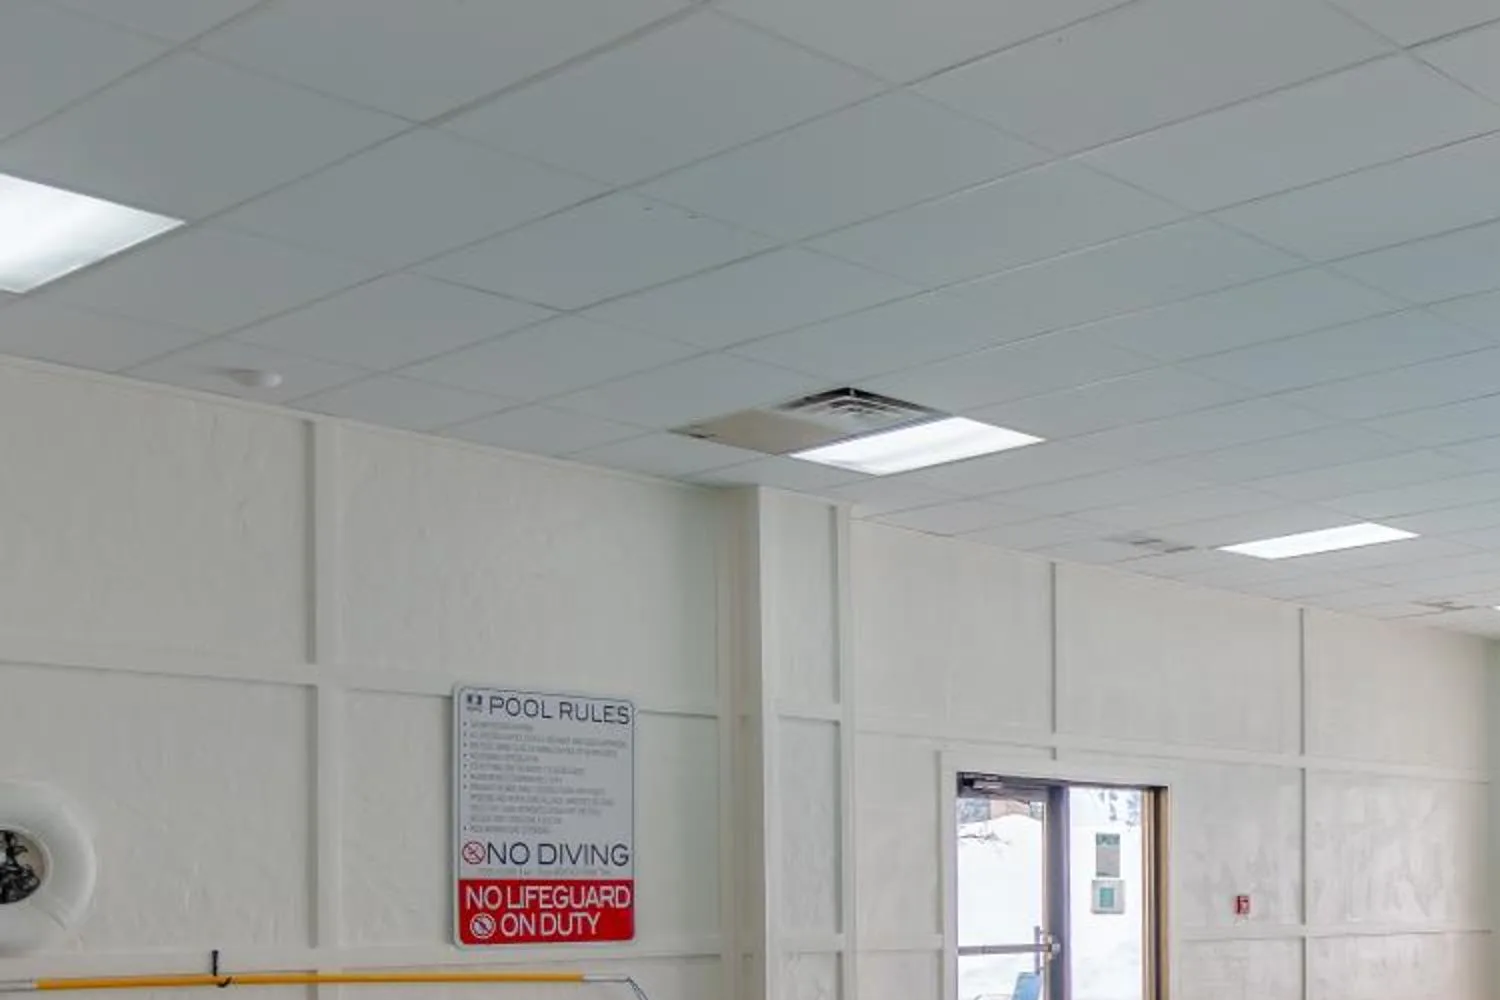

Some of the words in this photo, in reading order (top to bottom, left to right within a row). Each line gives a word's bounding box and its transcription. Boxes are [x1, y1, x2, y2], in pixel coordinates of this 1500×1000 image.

[489, 696, 552, 719] POOL
[559, 701, 631, 725] RULES
[487, 841, 531, 866] NO
[537, 842, 630, 867] DIVING
[466, 885, 502, 910] NO
[507, 884, 631, 910] LIFEGUARD
[501, 912, 535, 937] ON
[540, 911, 601, 936] DUTY
